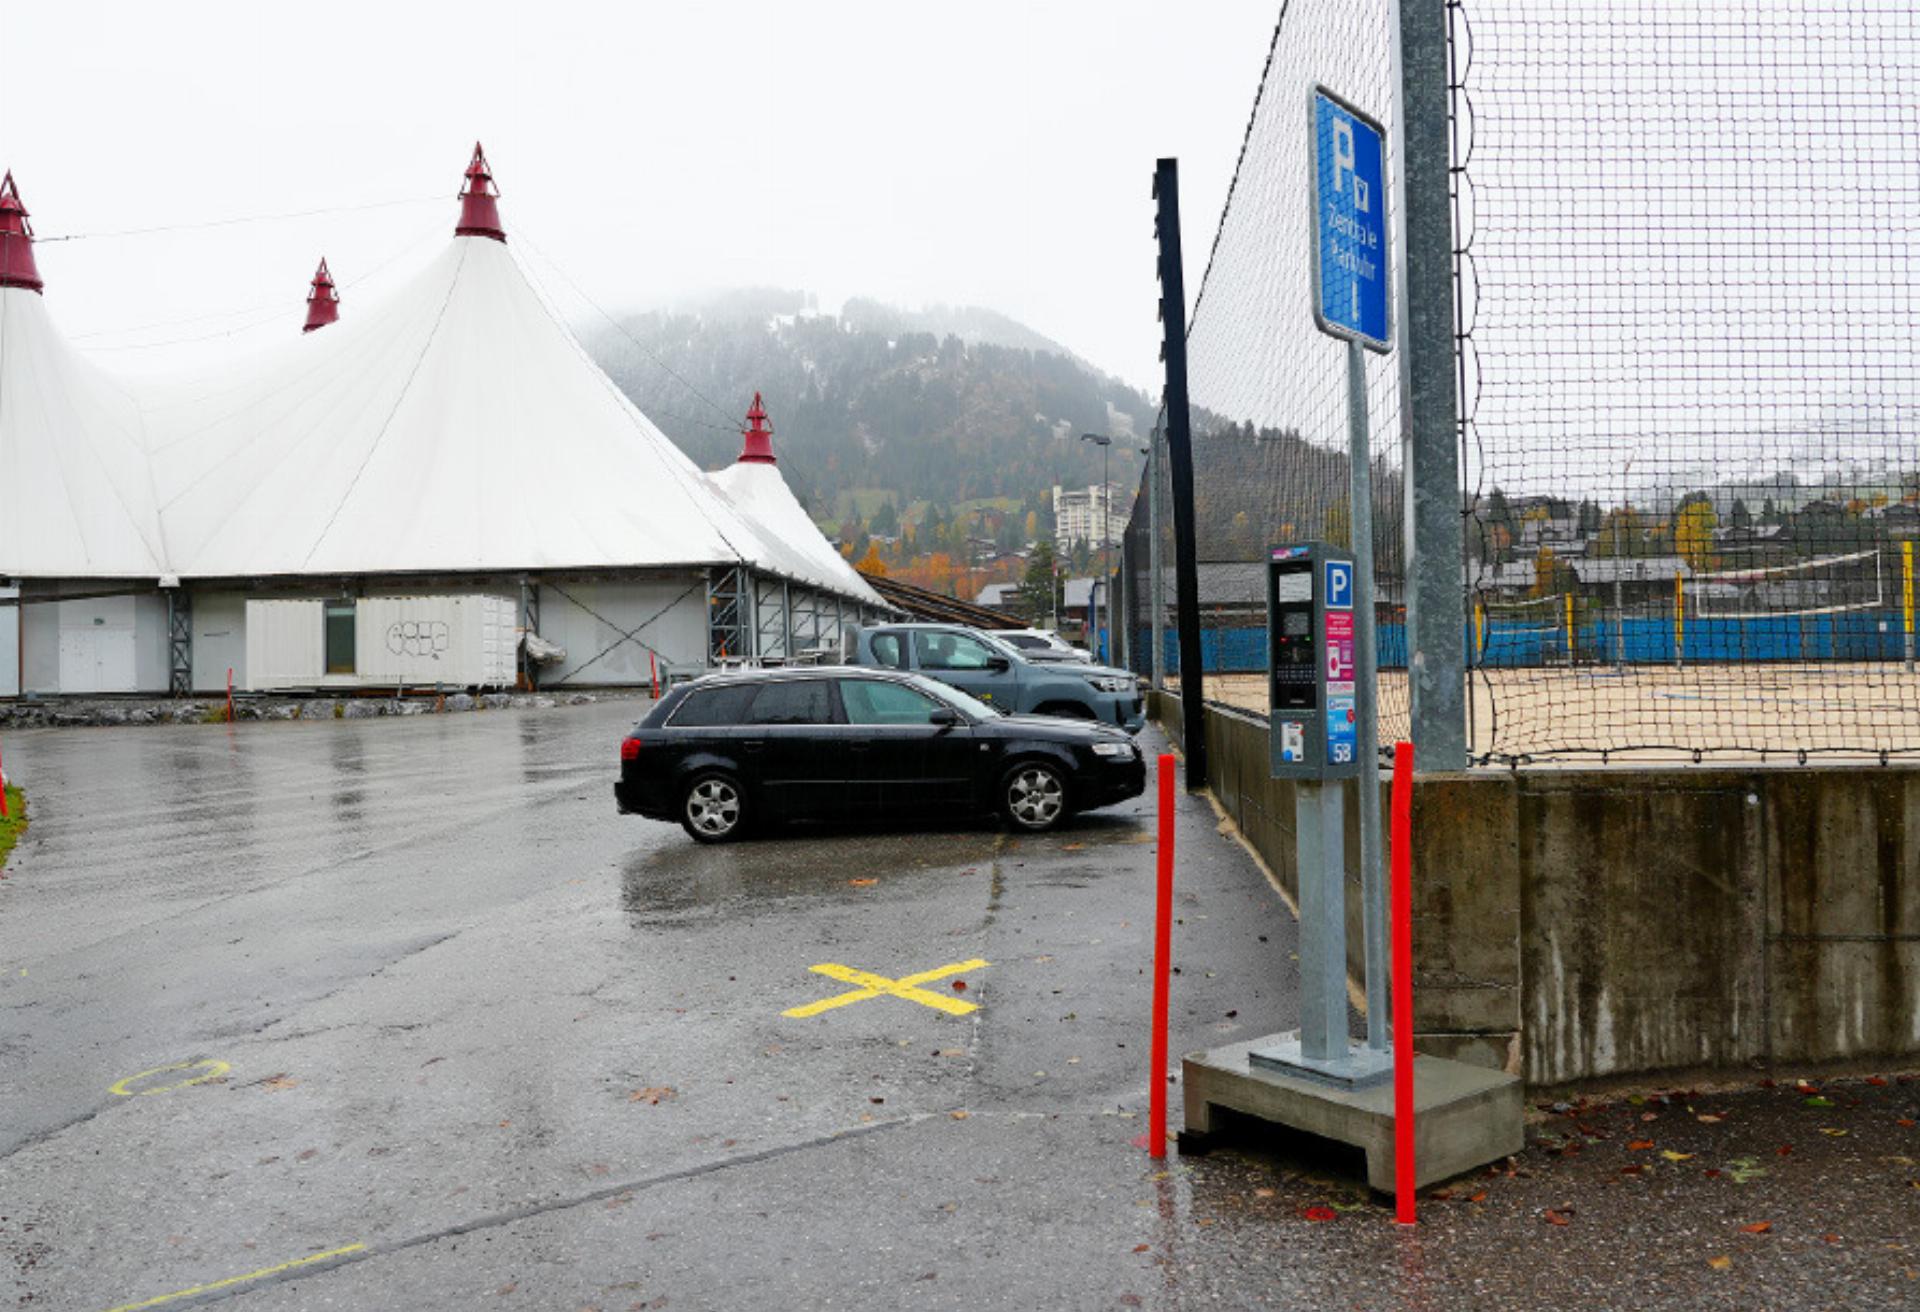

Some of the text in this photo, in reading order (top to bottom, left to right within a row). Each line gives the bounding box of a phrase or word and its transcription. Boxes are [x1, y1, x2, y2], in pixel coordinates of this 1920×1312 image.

[1333, 116, 1354, 192] P
[1328, 202, 1377, 250] Zentrale
[1332, 568, 1347, 602] P
